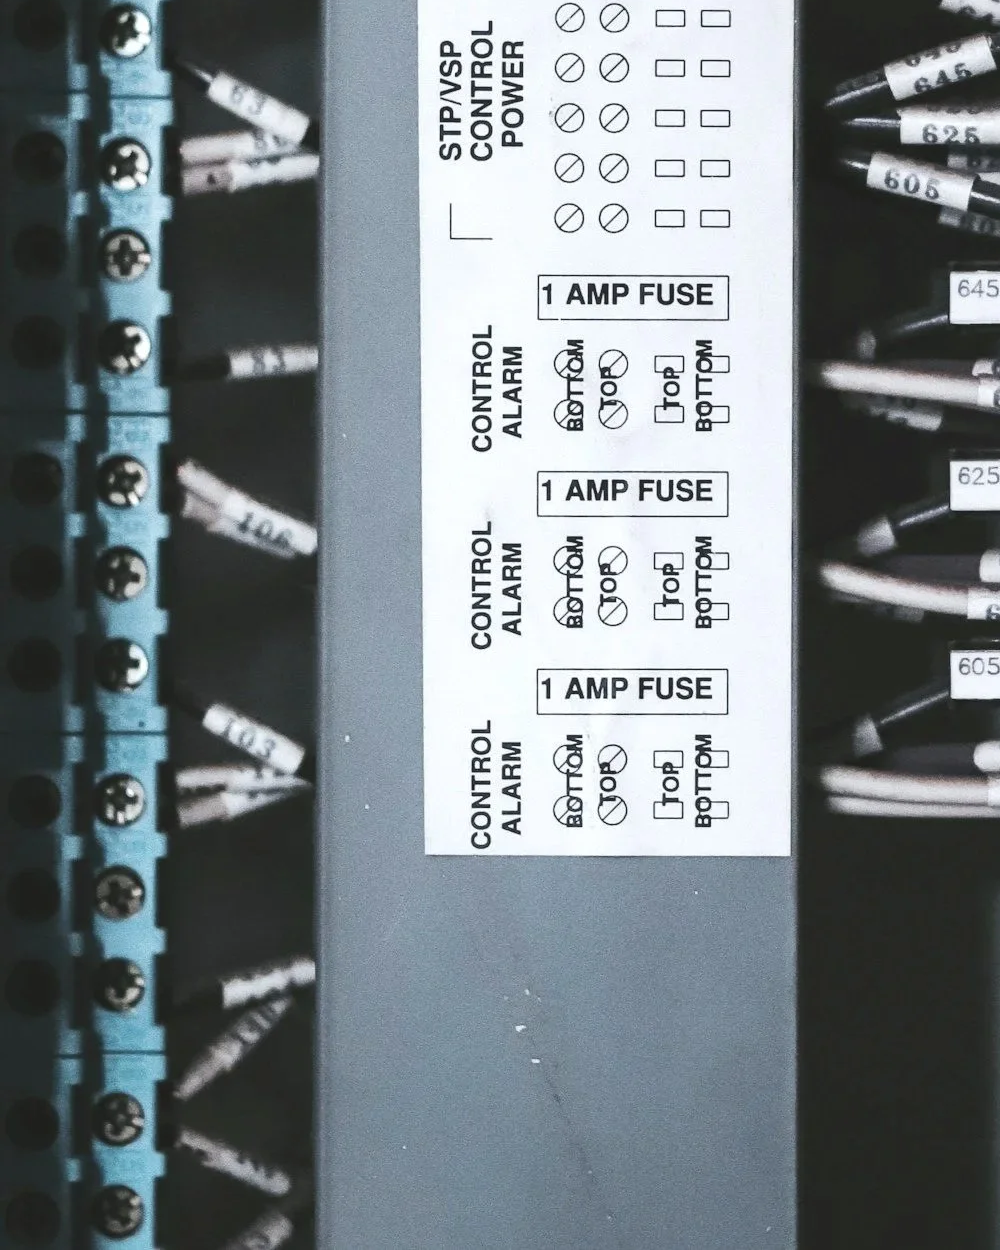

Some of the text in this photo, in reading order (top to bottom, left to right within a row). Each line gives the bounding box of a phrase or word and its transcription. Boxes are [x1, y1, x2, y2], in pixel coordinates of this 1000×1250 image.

[439, 41, 462, 160] STP/VSP
[470, 21, 493, 161] CONTROL
[502, 41, 524, 147] POWER
[884, 168, 941, 200] 605
[566, 283, 629, 305] AMP
[640, 283, 713, 305] FUSE
[957, 279, 1000, 298] 645
[472, 325, 492, 452] CONTROL
[503, 347, 522, 438] ALARM
[568, 339, 584, 431] BOTTOM
[600, 366, 617, 409] TOP
[664, 367, 680, 409] TOP
[696, 339, 712, 431] BOTTOM
[566, 480, 628, 501] AMP
[639, 479, 712, 502] FUSE
[958, 466, 1000, 486] 625
[471, 521, 491, 649] CONTROL
[502, 543, 521, 635] ALARM
[567, 536, 583, 628] BOTTOM
[600, 563, 617, 606] TOP
[663, 563, 680, 606] TOP
[696, 536, 712, 628] BOTTOM
[565, 677, 628, 699] AMP
[639, 677, 712, 700] FUSE
[958, 657, 1000, 675] 605
[471, 720, 491, 849] CONTROL
[502, 742, 521, 835] ALARM
[567, 735, 583, 827] BOTTOM
[600, 762, 616, 805] TOP
[663, 762, 680, 805] TOP
[695, 735, 712, 827] BOTTOM
